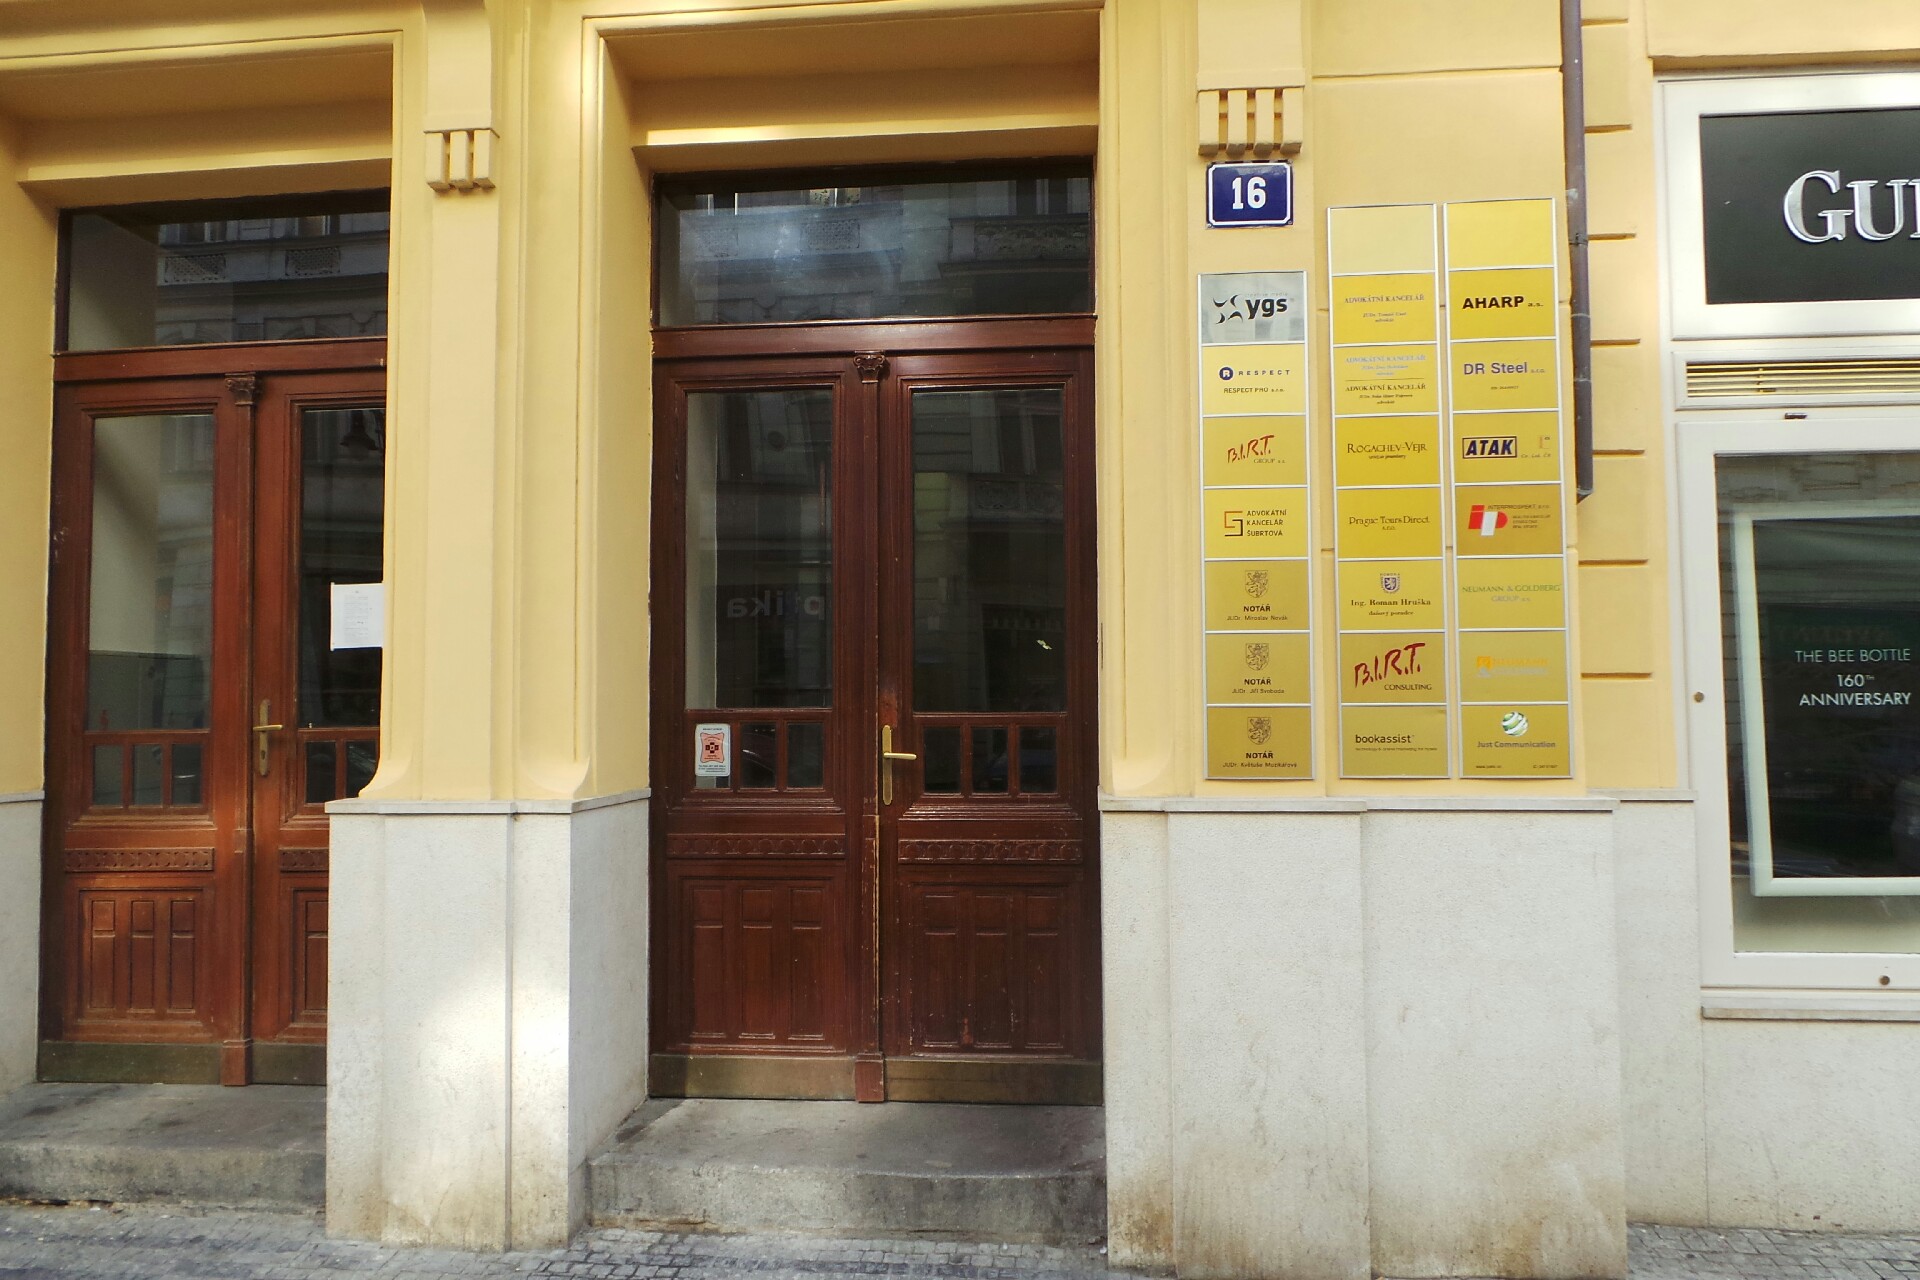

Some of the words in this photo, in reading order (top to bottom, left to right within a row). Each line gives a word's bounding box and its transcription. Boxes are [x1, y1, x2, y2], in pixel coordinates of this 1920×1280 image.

[1232, 177, 1266, 209] 16
[1783, 170, 1920, 243] GU
[1462, 296, 1524, 309] AHARP
[1245, 298, 1288, 320] ygs
[1463, 363, 1486, 375] DR
[1491, 362, 1528, 374] Steel
[1465, 439, 1514, 456] ATAK
[1348, 516, 1378, 527] Prague
[1379, 516, 1402, 524] Tours
[1403, 515, 1430, 524] Direct
[1462, 585, 1504, 593] NEUMANN
[1515, 584, 1560, 592] GOLDBERG
[1243, 603, 1271, 612] NOTÁŘ
[1350, 599, 1366, 607] Ing.
[1400, 598, 1431, 606] Hruška
[1795, 649, 1823, 663] THE
[1828, 649, 1855, 662] BEE
[1860, 648, 1911, 662] BOTTLE
[1244, 677, 1272, 686] NOTÁŘ
[1384, 683, 1432, 691] CONSULTING
[1799, 692, 1912, 706] ANNIVERSARY
[1355, 734, 1411, 744] bookassist
[1245, 750, 1274, 759] NOTÁŘ
